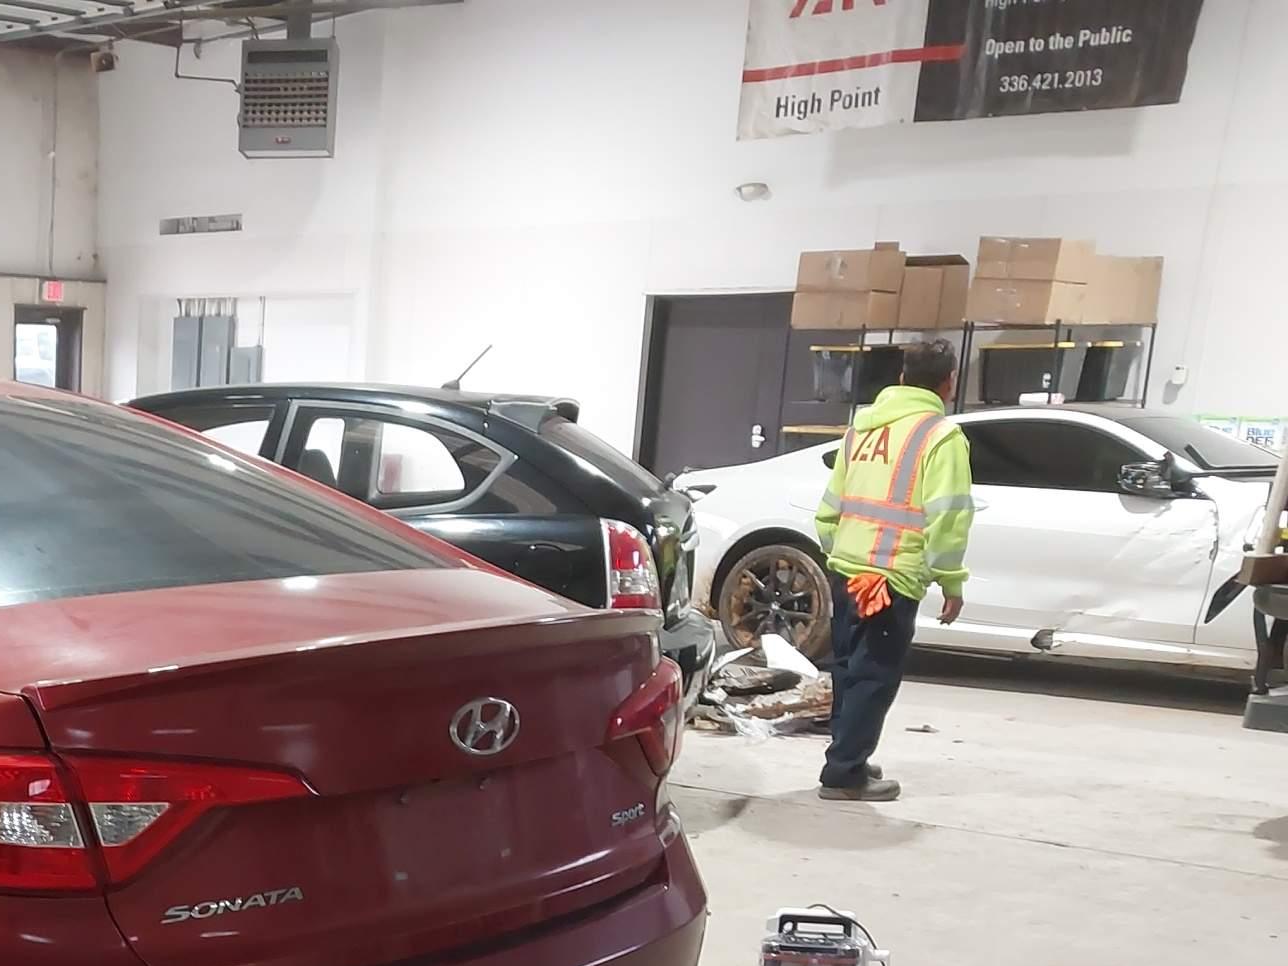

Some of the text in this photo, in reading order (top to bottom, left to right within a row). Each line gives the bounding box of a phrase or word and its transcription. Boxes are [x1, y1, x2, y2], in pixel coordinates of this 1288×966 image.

[985, 26, 1133, 59] Open to the Public
[999, 68, 1103, 93] 336.421.2013
[775, 86, 881, 120] High Point
[160, 887, 304, 924] SONATA
